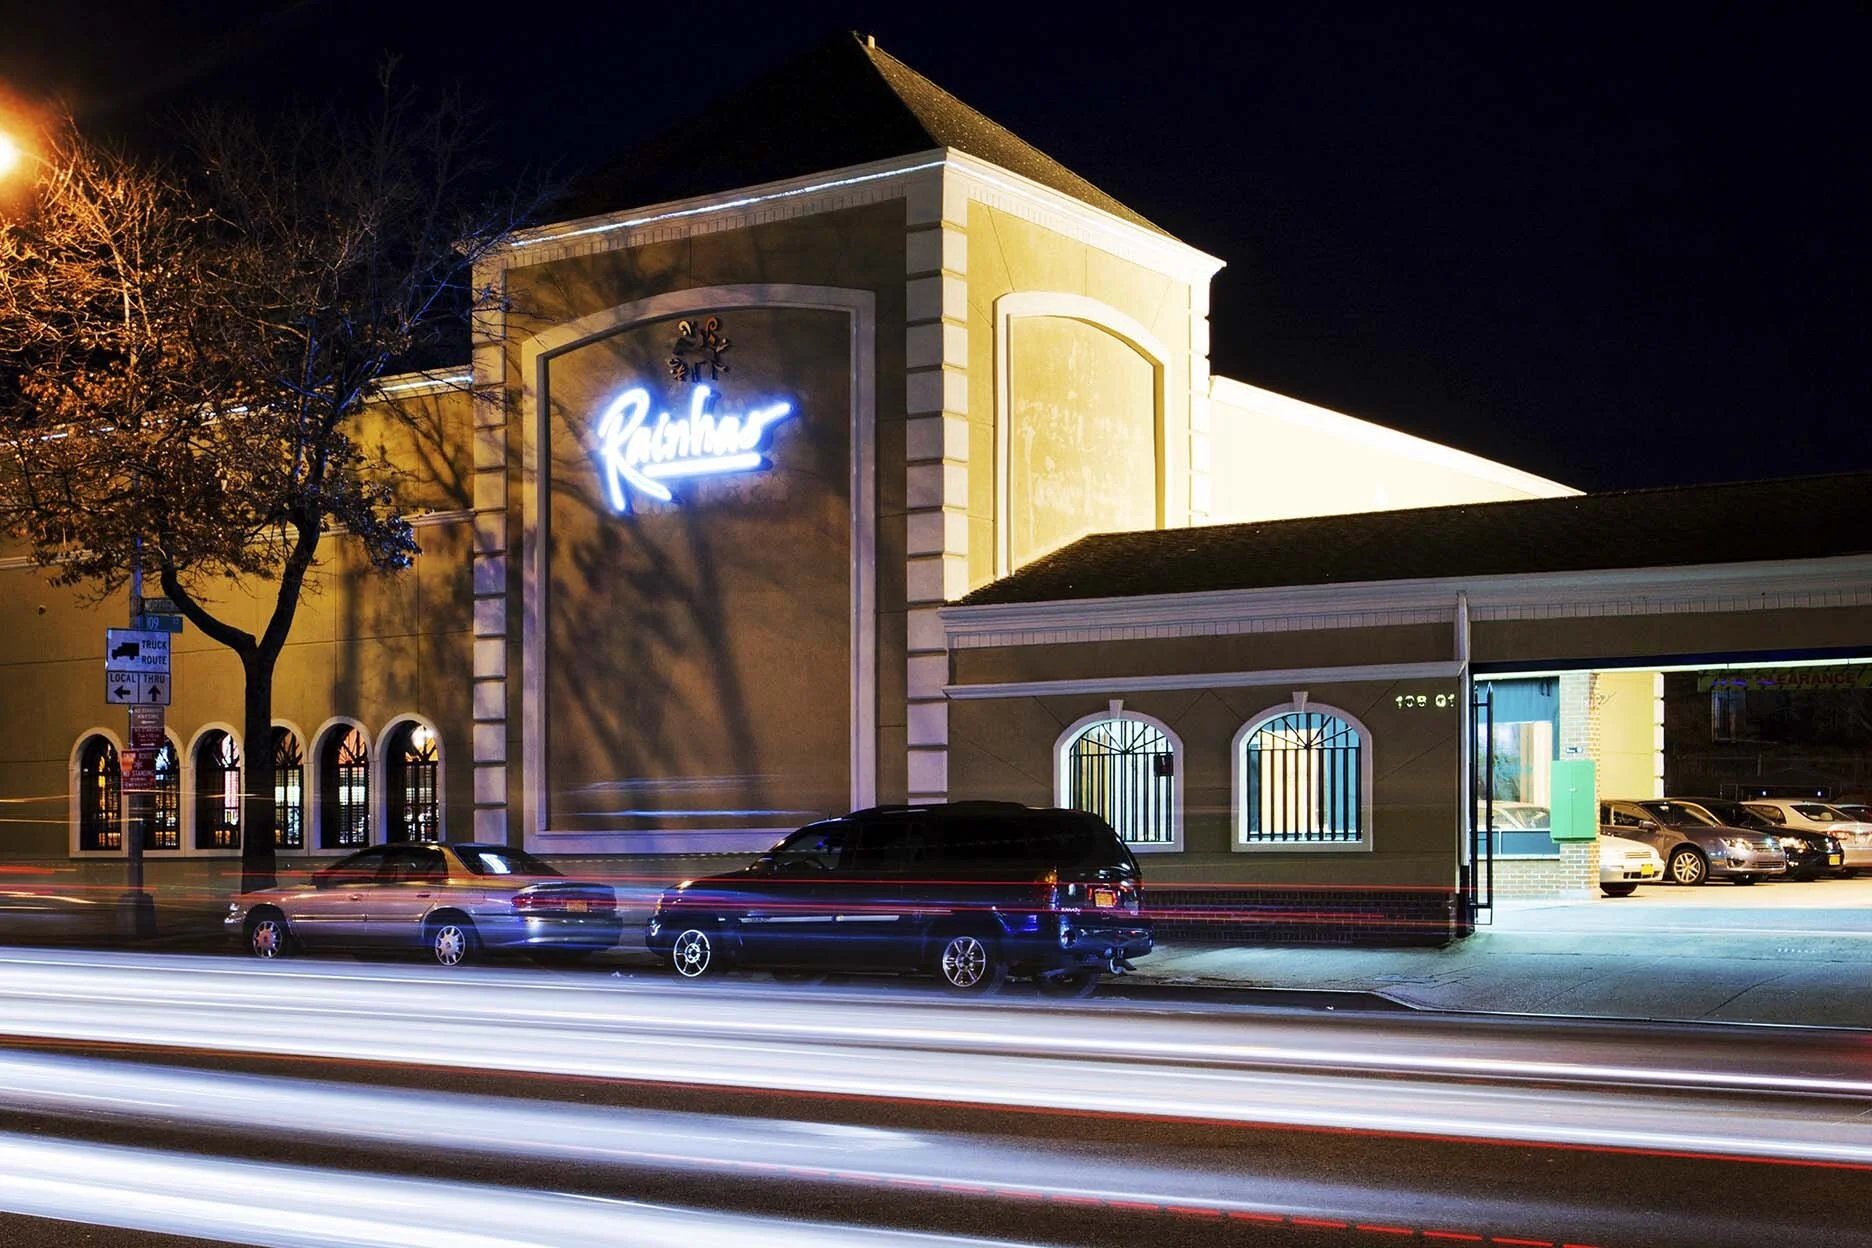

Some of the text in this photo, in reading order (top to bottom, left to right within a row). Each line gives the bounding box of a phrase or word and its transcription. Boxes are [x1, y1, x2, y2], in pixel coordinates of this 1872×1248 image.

[142, 640, 167, 650] TRUCK
[142, 655, 167, 665] ROUTE
[110, 674, 136, 683] LOCAL
[144, 674, 166, 684] THRU
